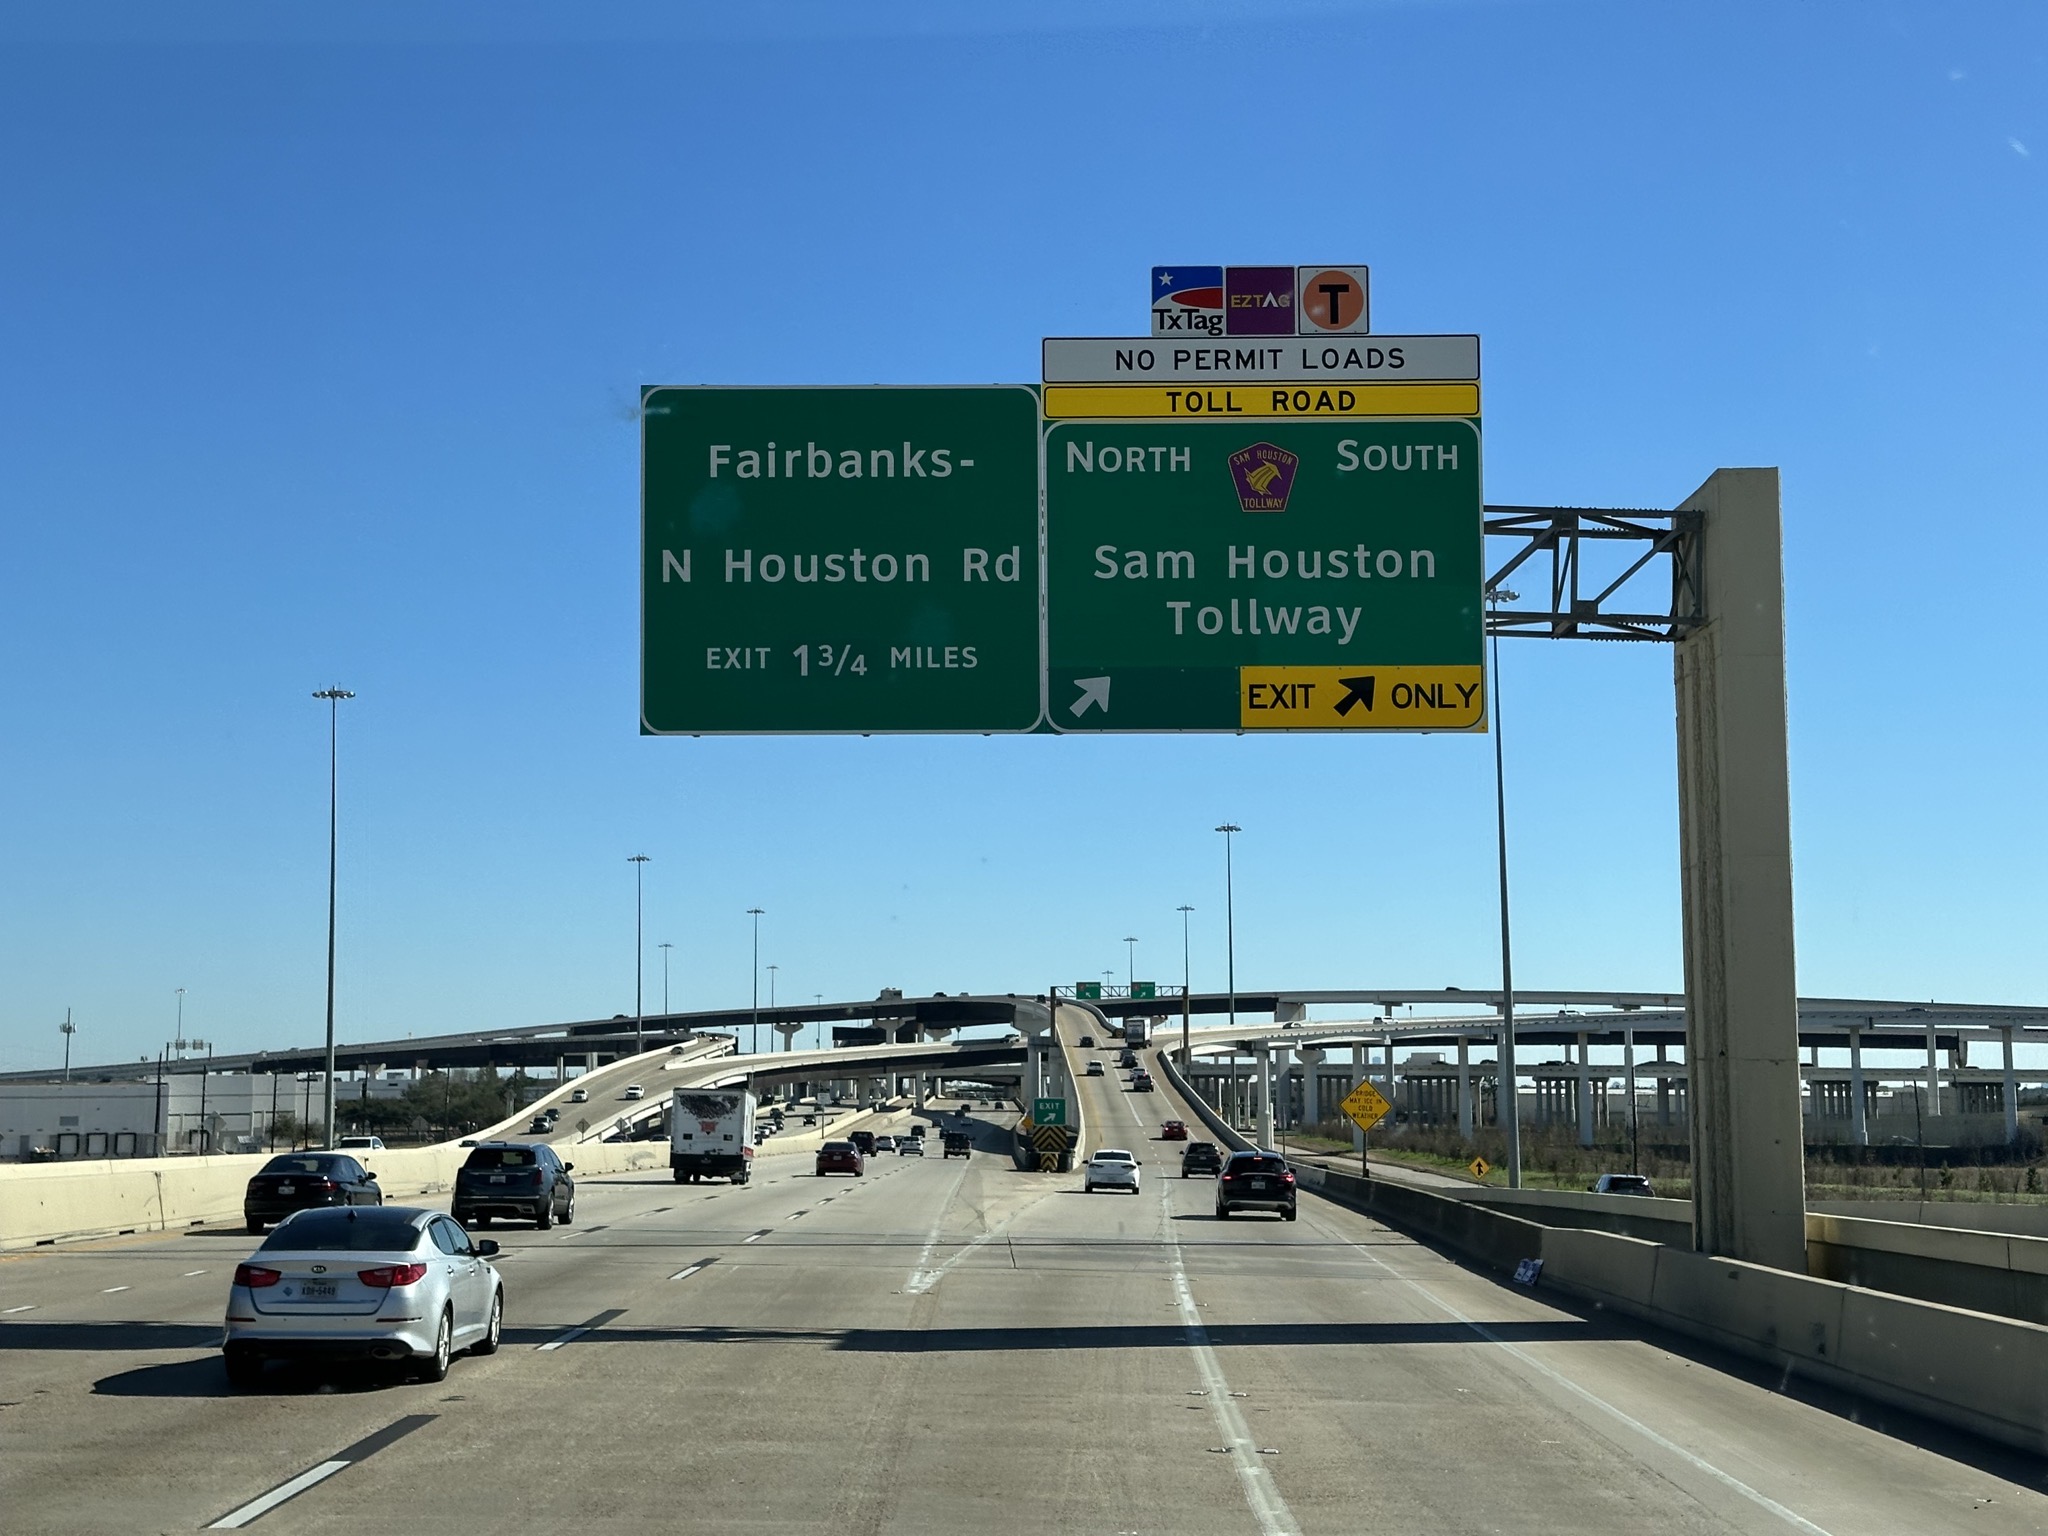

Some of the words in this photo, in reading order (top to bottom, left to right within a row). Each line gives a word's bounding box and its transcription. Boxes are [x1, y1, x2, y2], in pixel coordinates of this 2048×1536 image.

[1318, 284, 1350, 325] T
[1152, 308, 1224, 336] TxTag
[1115, 349, 1156, 371] NO
[1174, 348, 1284, 371] PERMIT
[1302, 347, 1406, 370] LOADS
[1166, 391, 1243, 413] TOLL
[1272, 390, 1357, 412] ROAD
[709, 441, 975, 479] Fairbanks-
[1066, 441, 1191, 473] NORTH
[1233, 452, 1251, 466] SAM
[1256, 449, 1294, 466] HOUSTON
[1336, 439, 1458, 472] SOUTH
[1243, 497, 1284, 508] TOLLWAY
[661, 548, 692, 583] N
[724, 548, 931, 583] Houston
[963, 545, 1021, 583] Rd
[1093, 544, 1196, 580] Sam
[1228, 543, 1436, 580] Houston
[1166, 598, 1363, 645] Tollway
[705, 646, 771, 669] EXIT
[890, 646, 979, 668] MILES
[1248, 684, 1316, 710] EXIT
[1391, 682, 1479, 710] ONLY
[1039, 1102, 1060, 1110] EXIT
